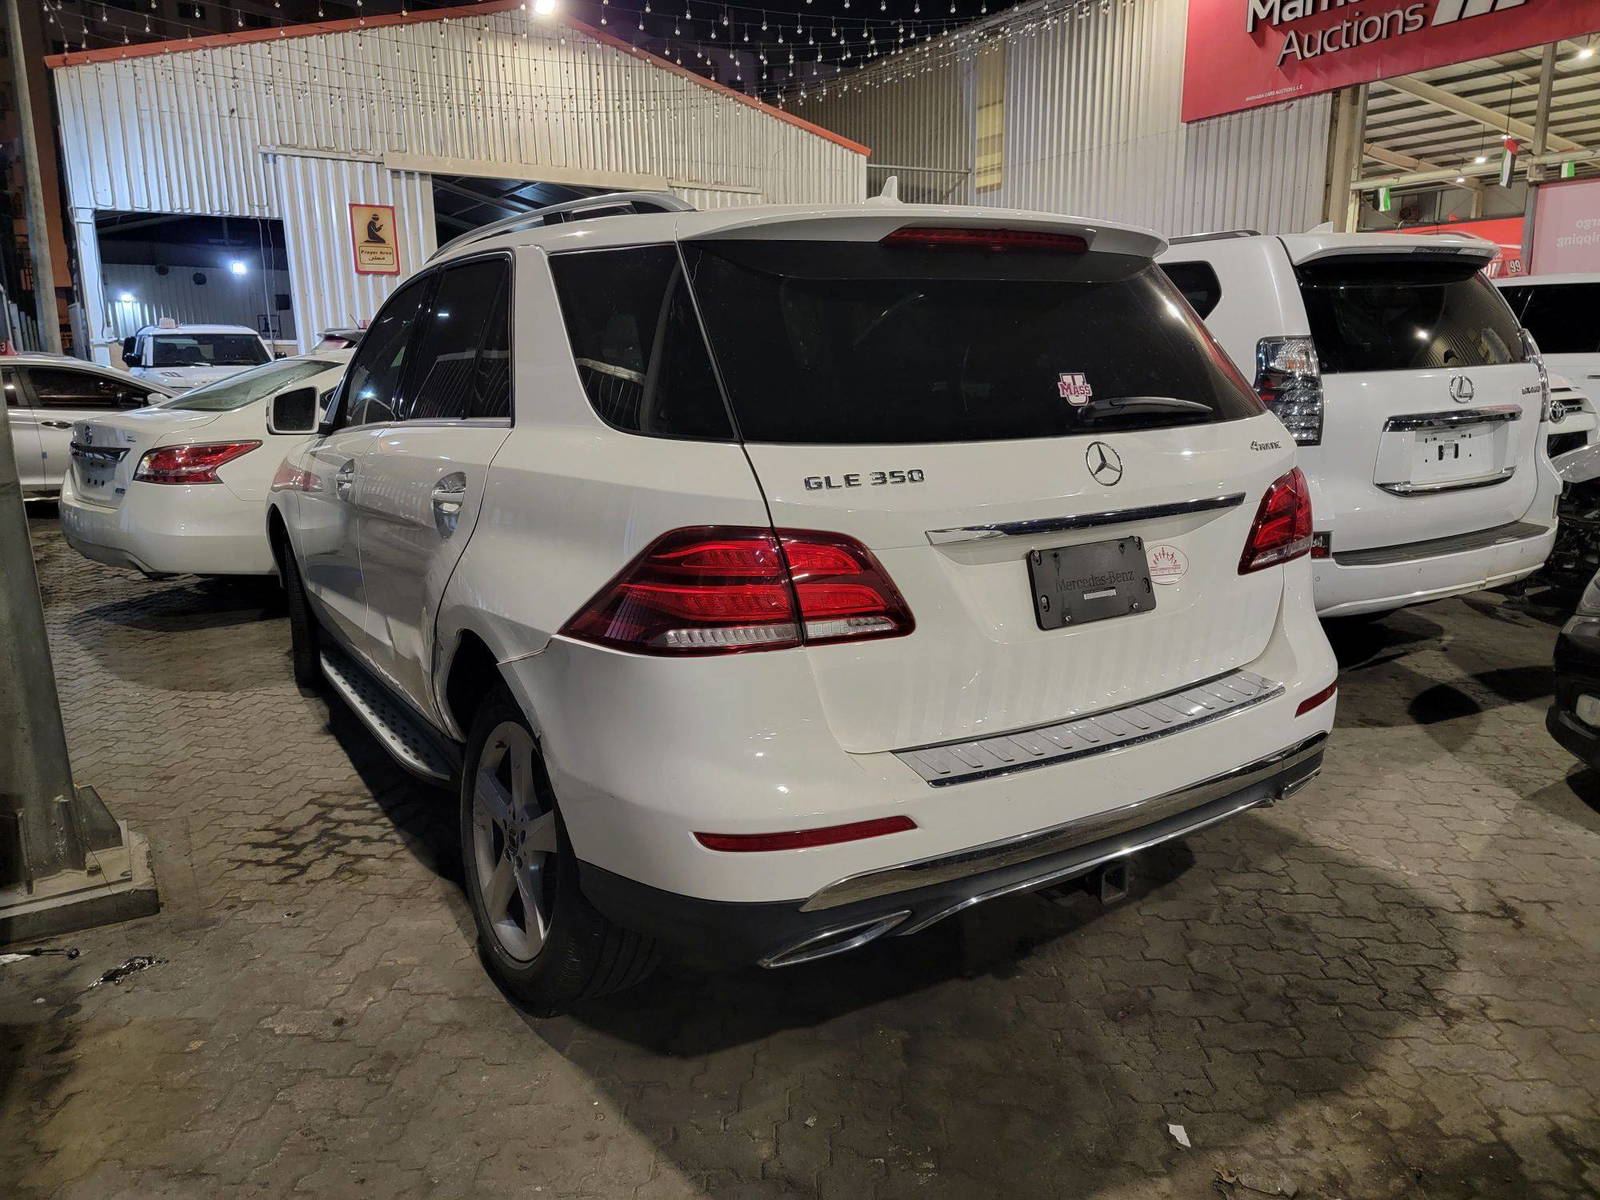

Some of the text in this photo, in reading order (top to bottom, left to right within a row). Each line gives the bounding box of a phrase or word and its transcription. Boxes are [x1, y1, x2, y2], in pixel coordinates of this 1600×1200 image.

[1276, 3, 1424, 66] Auctions
[1510, 260, 1521, 273] 99
[804, 469, 925, 491] GLE 350
[1055, 570, 1135, 593] Mercedes-Benz
